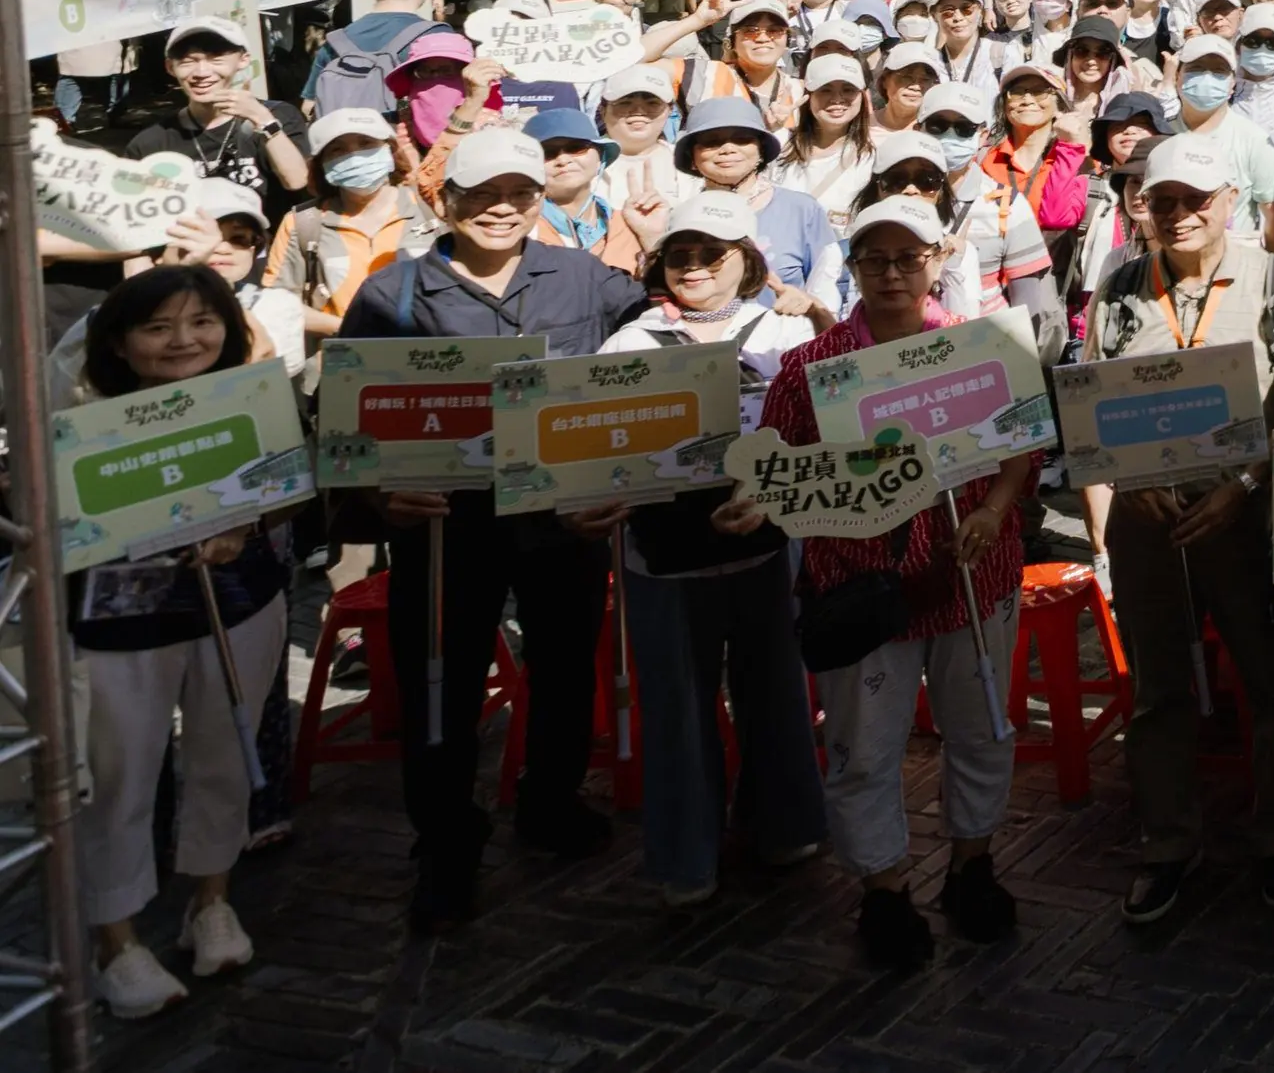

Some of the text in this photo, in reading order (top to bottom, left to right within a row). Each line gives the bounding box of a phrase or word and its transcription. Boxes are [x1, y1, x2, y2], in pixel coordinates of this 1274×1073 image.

[65, 3, 78, 23] B
[491, 22, 559, 47] 史蹟
[364, 395, 493, 411] 好南玩！城南往日漫
[872, 374, 996, 419] 城西職人記憶走讀
[422, 413, 442, 432] A
[931, 408, 950, 427] B
[1156, 417, 1172, 432] C
[609, 429, 630, 449] B
[160, 464, 184, 486] B
[754, 450, 837, 490] 史蹟
